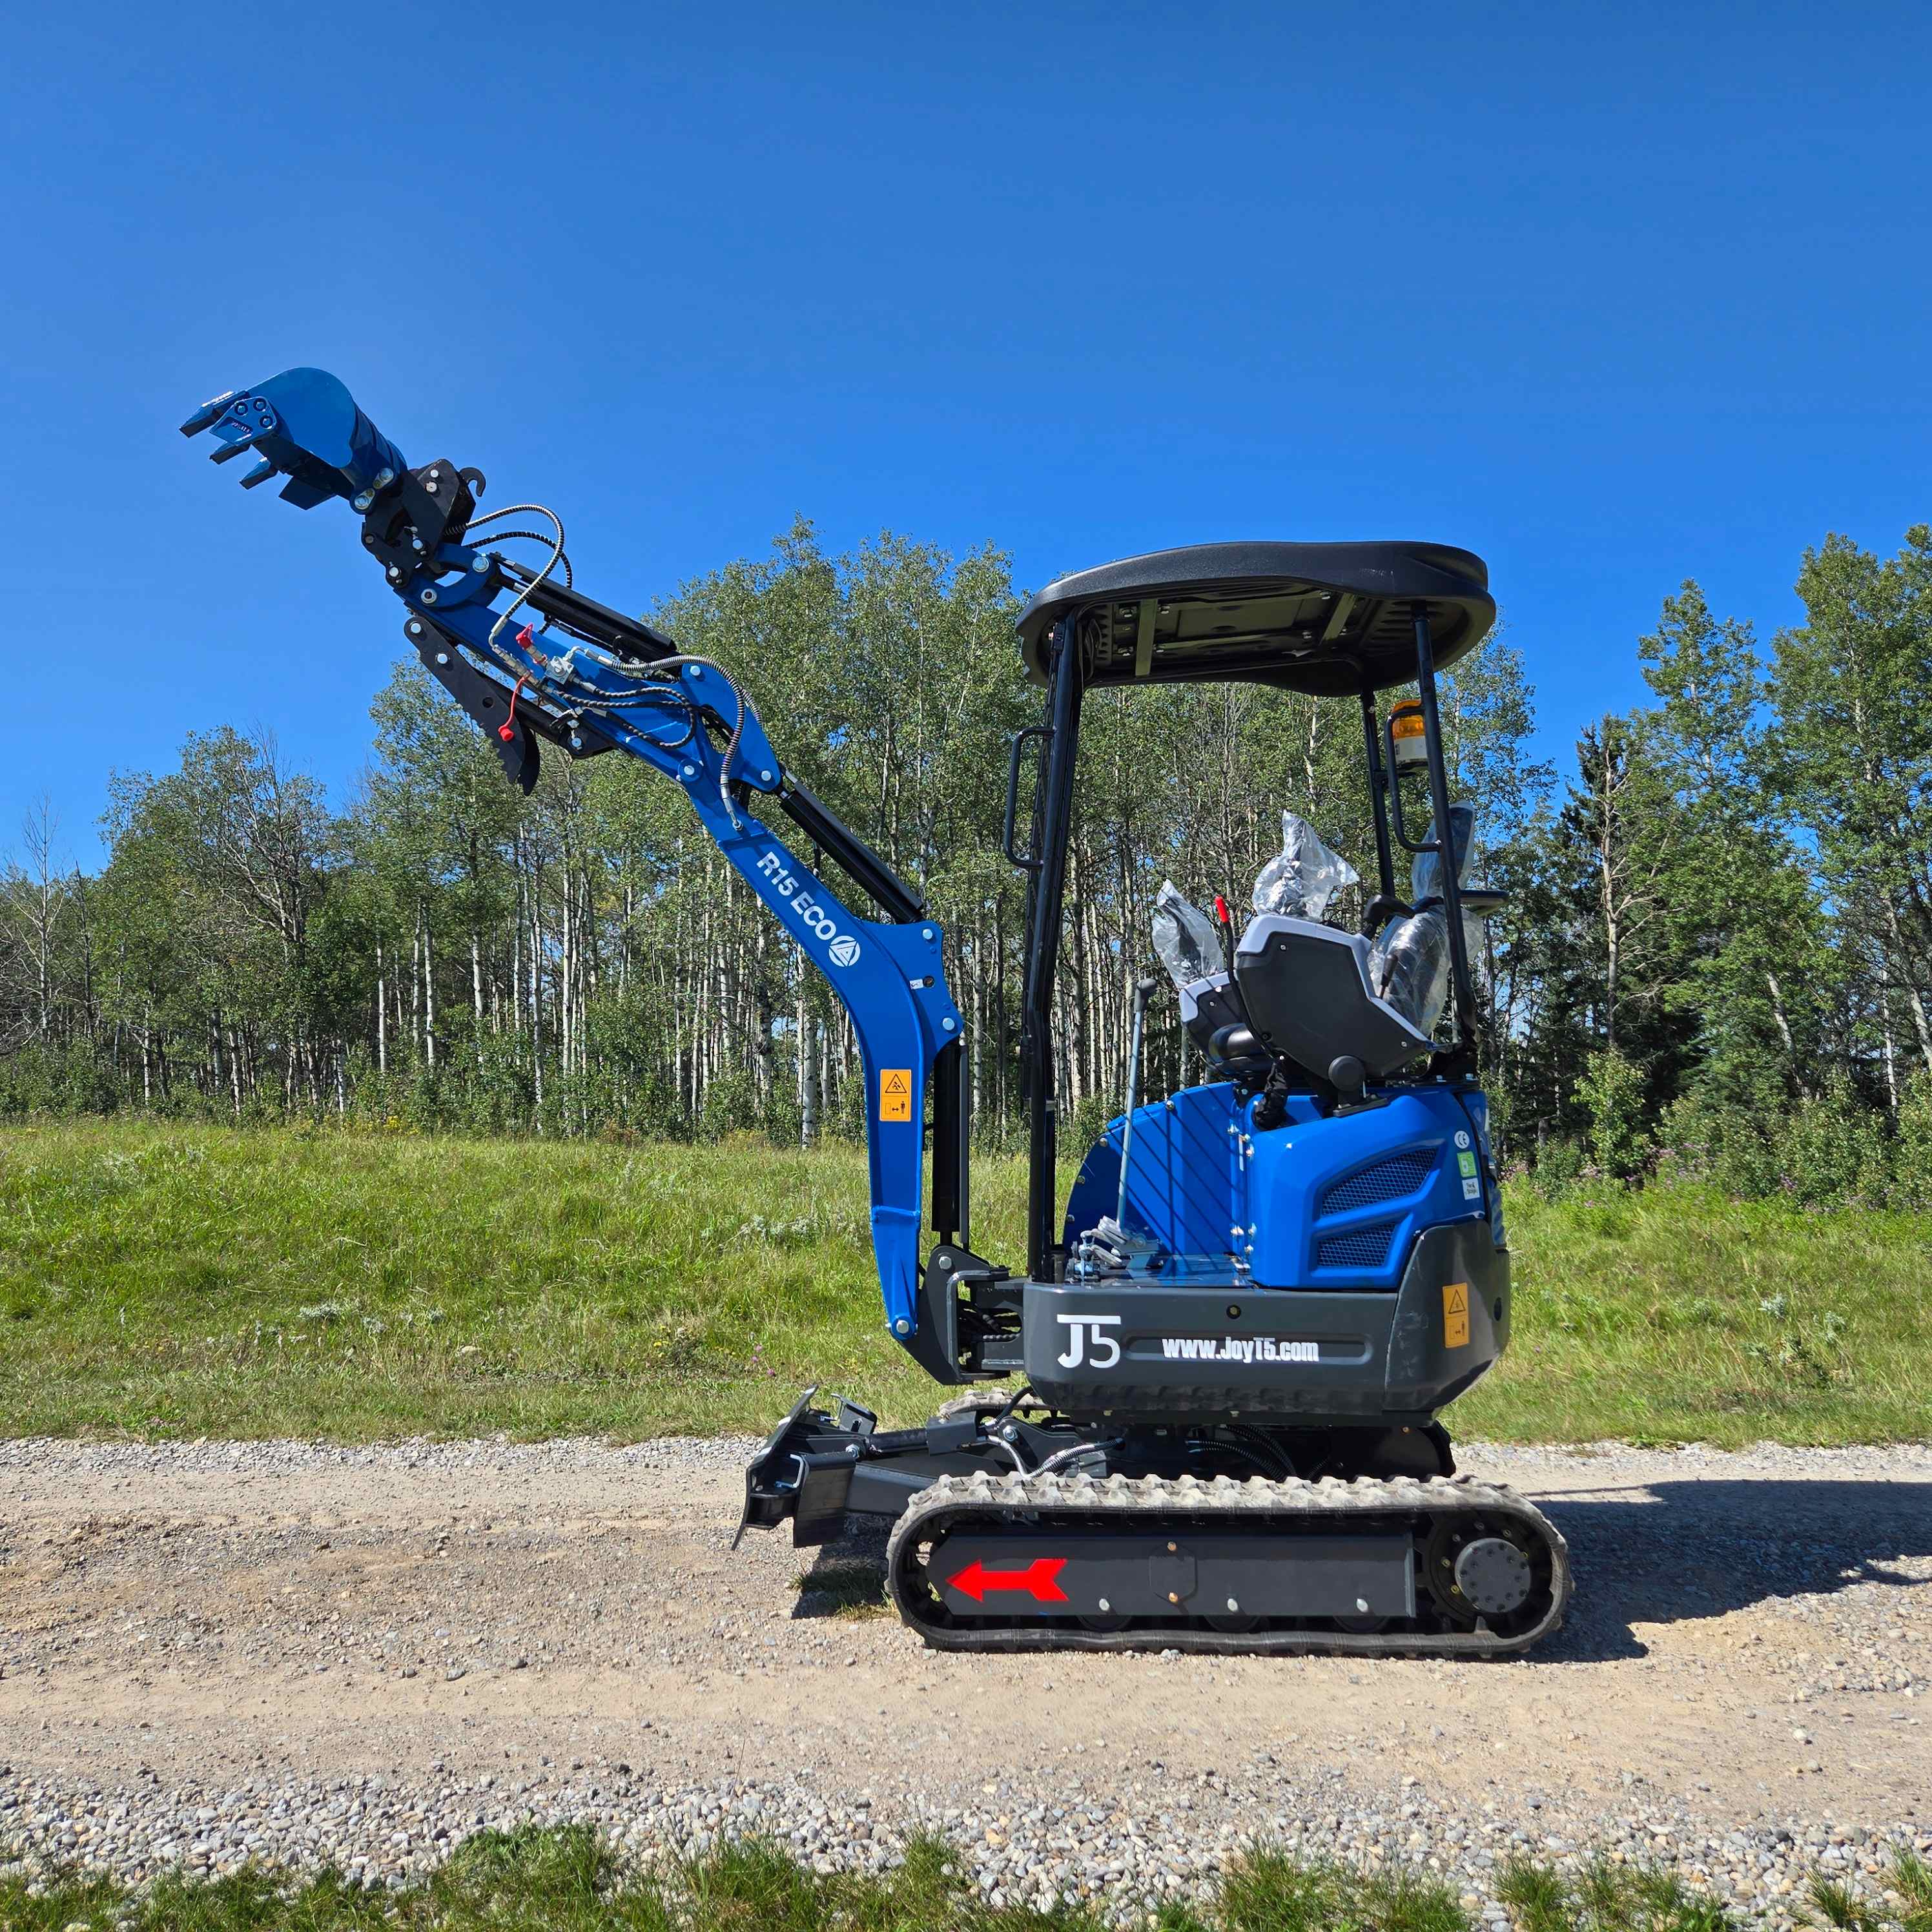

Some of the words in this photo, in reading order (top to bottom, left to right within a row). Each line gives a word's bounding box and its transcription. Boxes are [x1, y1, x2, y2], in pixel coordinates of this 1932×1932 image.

[756, 851, 799, 896] R15
[790, 891, 837, 941] ECO
[1162, 1336, 1320, 1364] www.JoyT5.com
